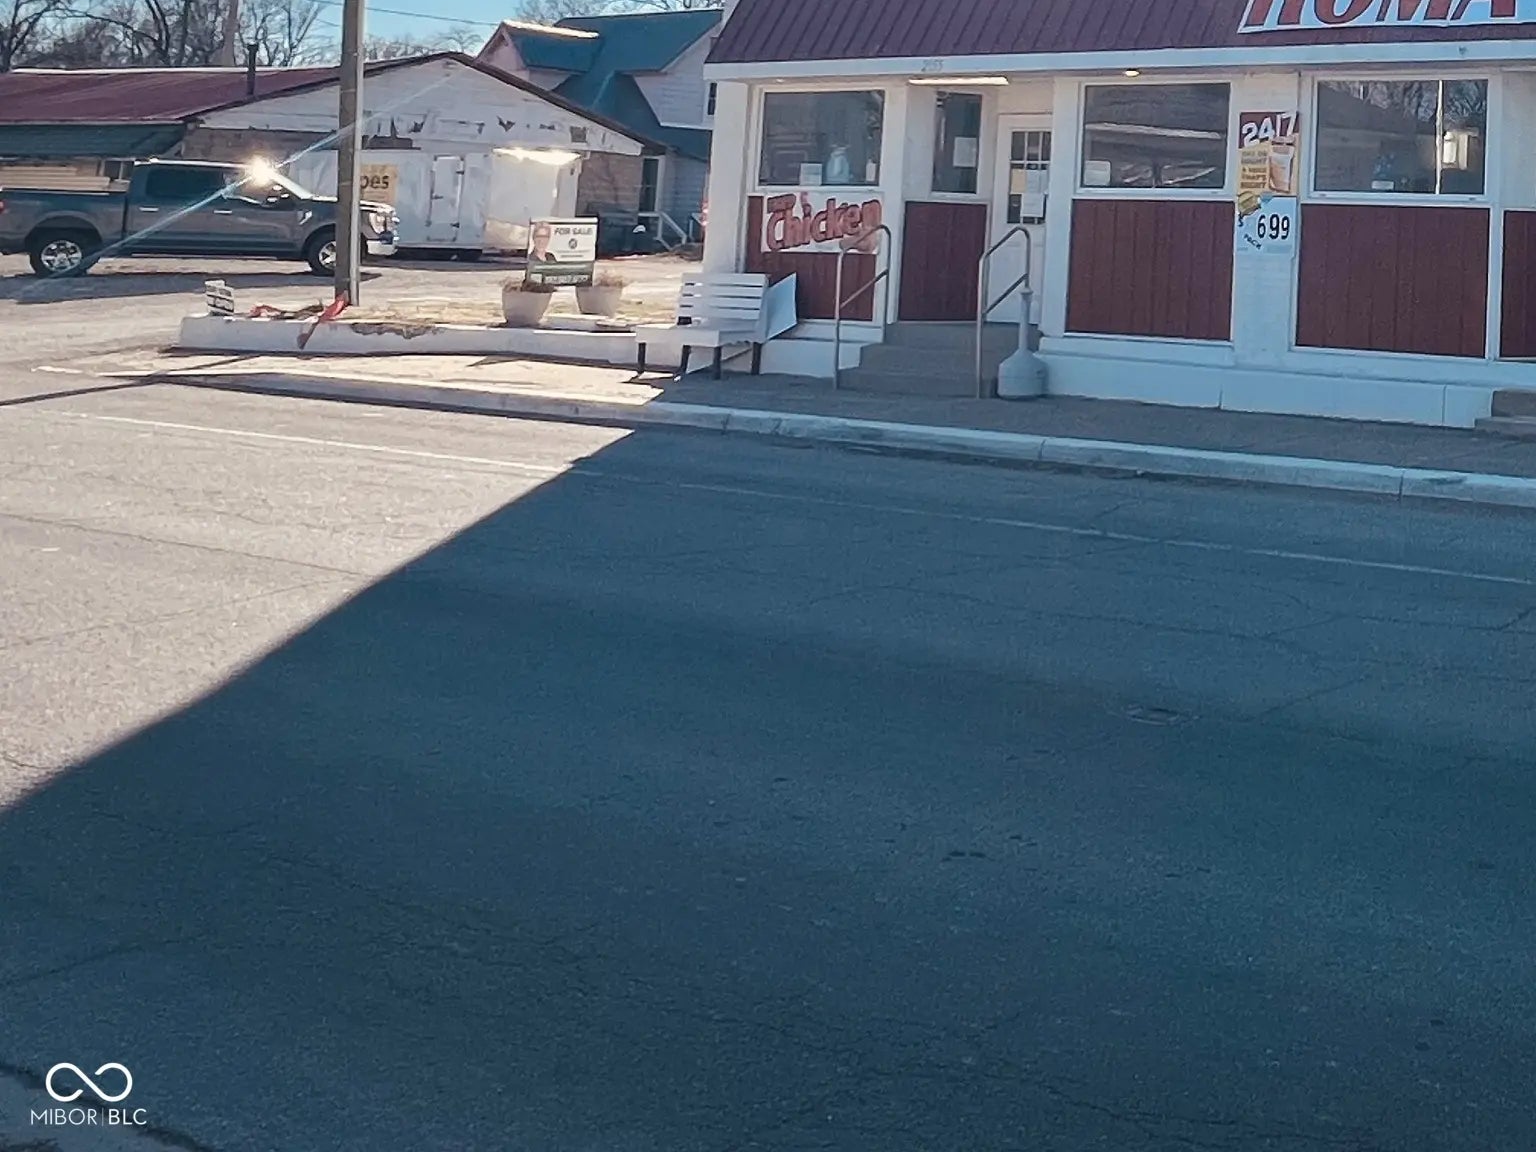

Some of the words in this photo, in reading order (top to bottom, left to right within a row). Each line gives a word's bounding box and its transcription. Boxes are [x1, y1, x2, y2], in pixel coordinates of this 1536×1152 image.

[553, 227, 570, 235] FOR
[572, 227, 593, 235] SALE
[767, 193, 882, 250] Chicken
